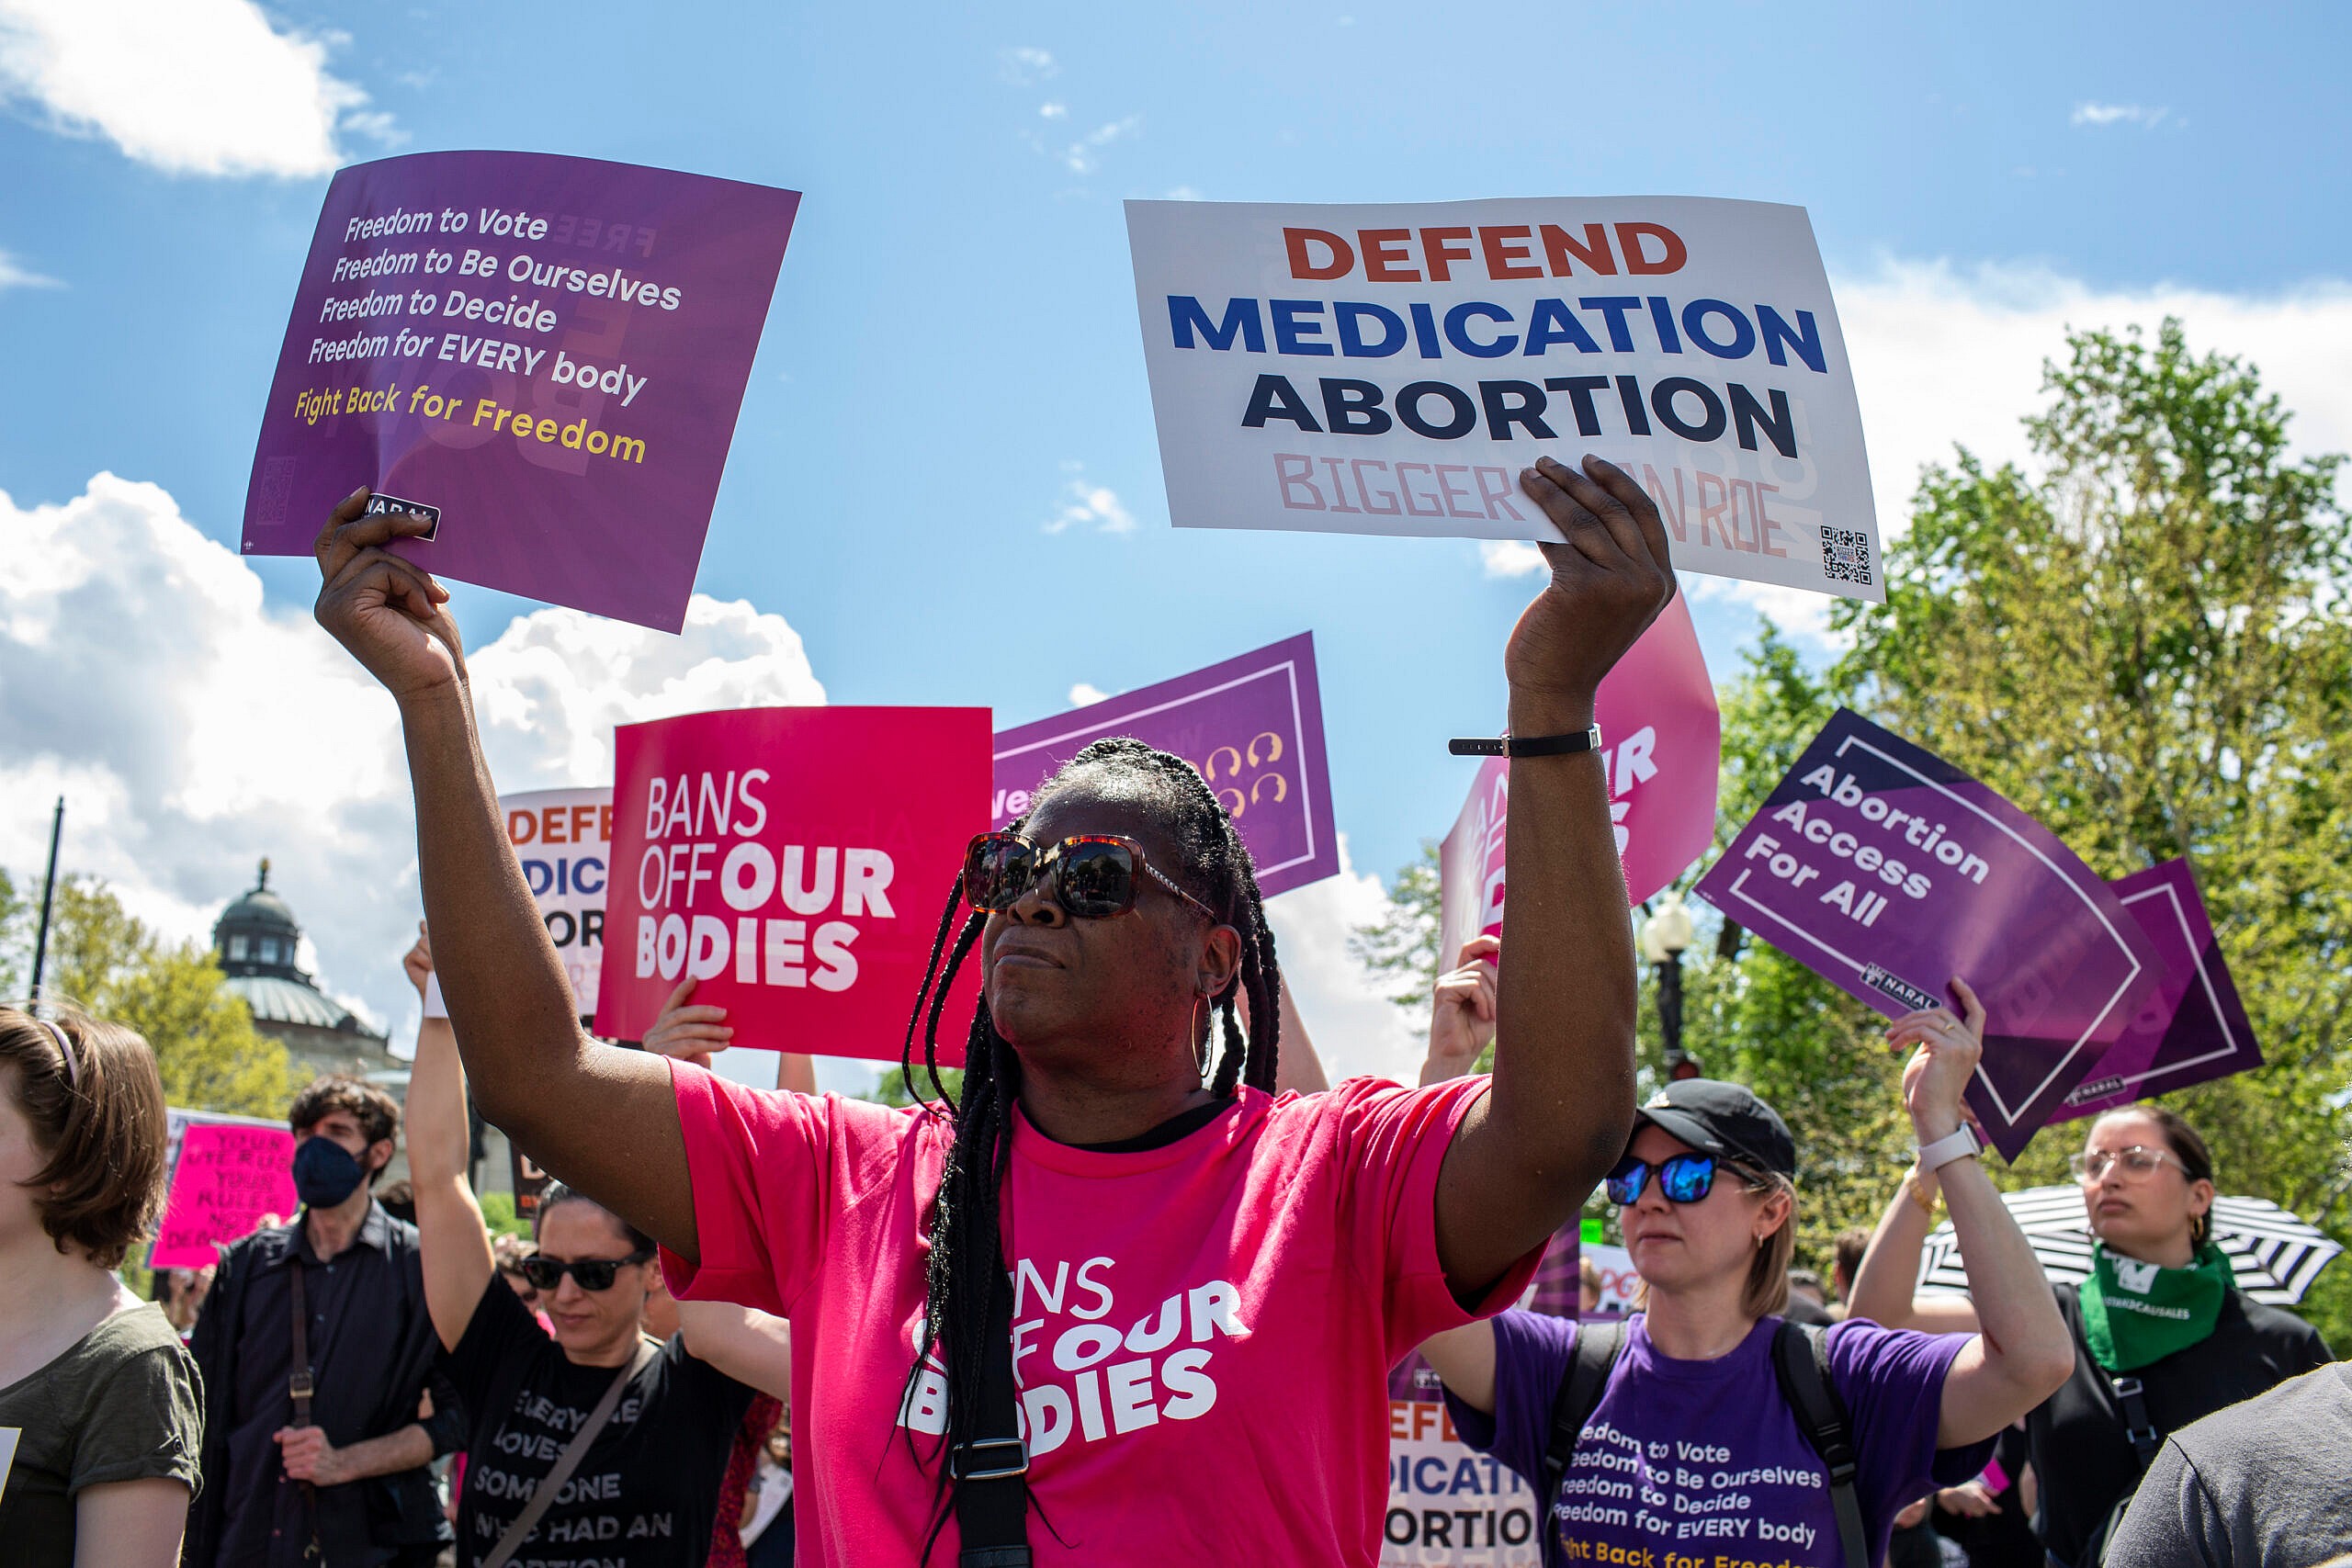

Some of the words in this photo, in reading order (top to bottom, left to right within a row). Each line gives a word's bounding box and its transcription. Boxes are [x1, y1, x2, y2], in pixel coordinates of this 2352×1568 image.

[344, 207, 433, 243] Freedom
[440, 205, 469, 234] to
[477, 208, 548, 242] Vote
[1283, 221, 1687, 284] DEFEND
[320, 289, 403, 324] Freedom
[409, 289, 437, 317] to
[443, 289, 557, 334] Decide
[332, 249, 418, 284] Freedom
[423, 248, 452, 275] to
[458, 249, 498, 277] Be
[507, 254, 683, 311] Ourselves
[308, 332, 389, 365] Freedom
[392, 327, 433, 359] for
[437, 333, 546, 378] EVERY
[551, 351, 648, 407] body
[1167, 294, 1827, 375] MEDICATION
[294, 389, 343, 426] Fight
[346, 382, 402, 415] Back
[408, 384, 462, 422] for
[471, 399, 647, 465] Freedom
[1241, 373, 1798, 460] ABORTION
[1273, 453, 1526, 522] BIGGER
[1696, 470, 1787, 558] ROE
[646, 768, 771, 840] BANS
[1801, 763, 1990, 886] Abortion
[639, 842, 717, 909] OFF
[720, 841, 897, 919] OUR
[1744, 832, 1820, 890] For
[1821, 877, 1889, 928] All
[1772, 799, 1932, 901] Access
[636, 914, 861, 993] BODIES
[1014, 1257, 1116, 1320] NS
[1053, 1280, 1252, 1372] OUR
[897, 1348, 1218, 1459] BDIES
[1571, 1448, 1639, 1473] eedom
[1645, 1464, 1671, 1485] to
[1676, 1468, 1704, 1491] Be
[1711, 1466, 1823, 1489] Ourselves
[1578, 1423, 1642, 1454] edom
[1648, 1440, 1669, 1460] to
[1677, 1441, 1731, 1463] Vote
[474, 1464, 622, 1506] SOMONE
[1562, 1474, 1634, 1499] reedom
[1640, 1485, 1668, 1507] to
[1674, 1492, 1752, 1516] Decide
[548, 1516, 621, 1543] HAD
[627, 1512, 673, 1540] AN
[1385, 1507, 1532, 1549] ORTIO
[1596, 1541, 1655, 1568] Back
[1634, 1509, 1672, 1536] for
[1677, 1518, 1751, 1540] EVERY
[1758, 1517, 1816, 1551] body
